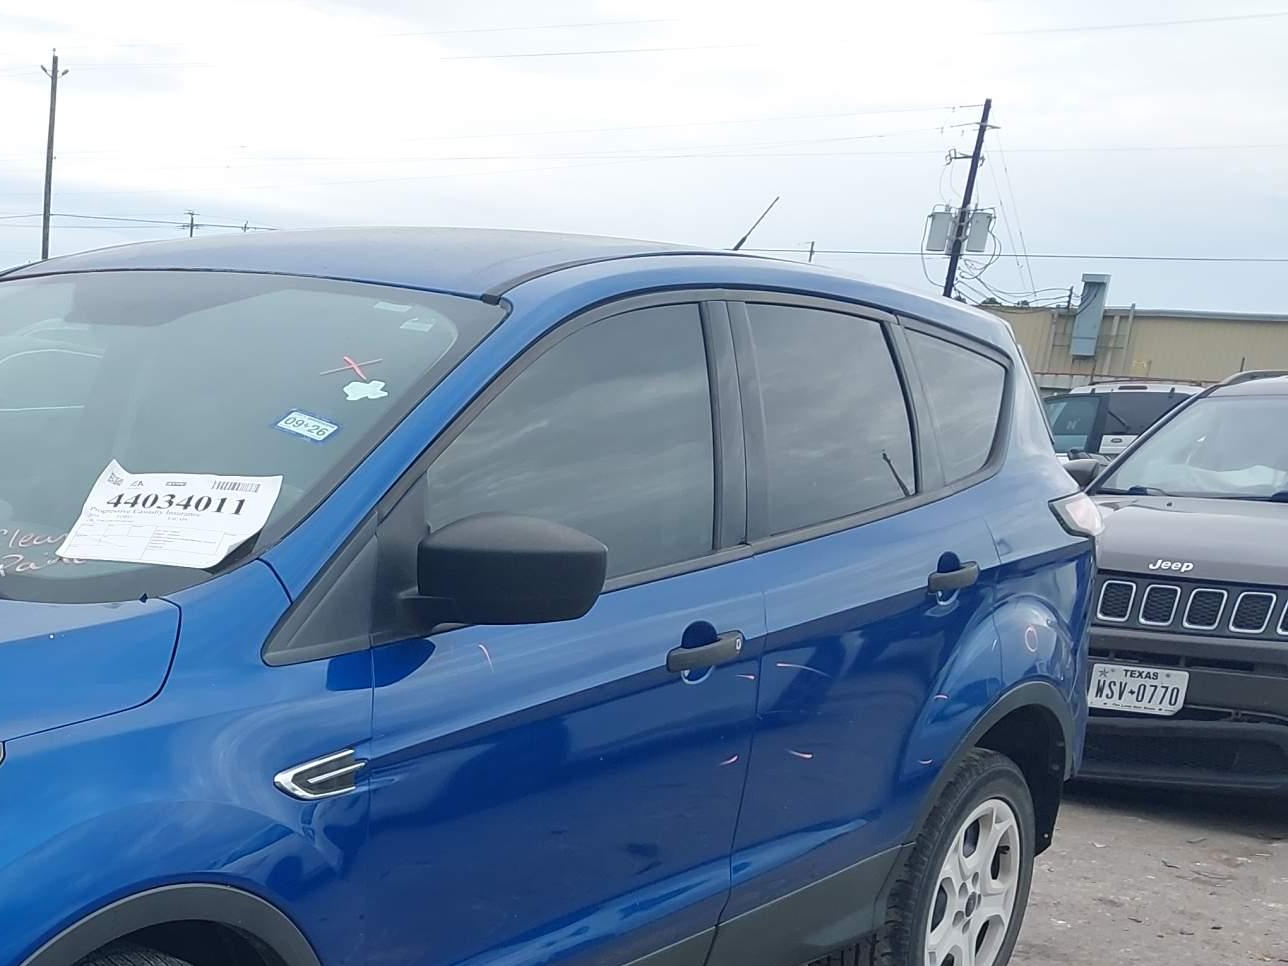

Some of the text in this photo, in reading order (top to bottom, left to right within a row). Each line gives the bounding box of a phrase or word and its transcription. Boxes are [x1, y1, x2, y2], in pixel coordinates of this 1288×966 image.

[106, 492, 246, 516] 44034011
[1148, 560, 1194, 573] Jeep
[1123, 669, 1159, 680] TEXAS
